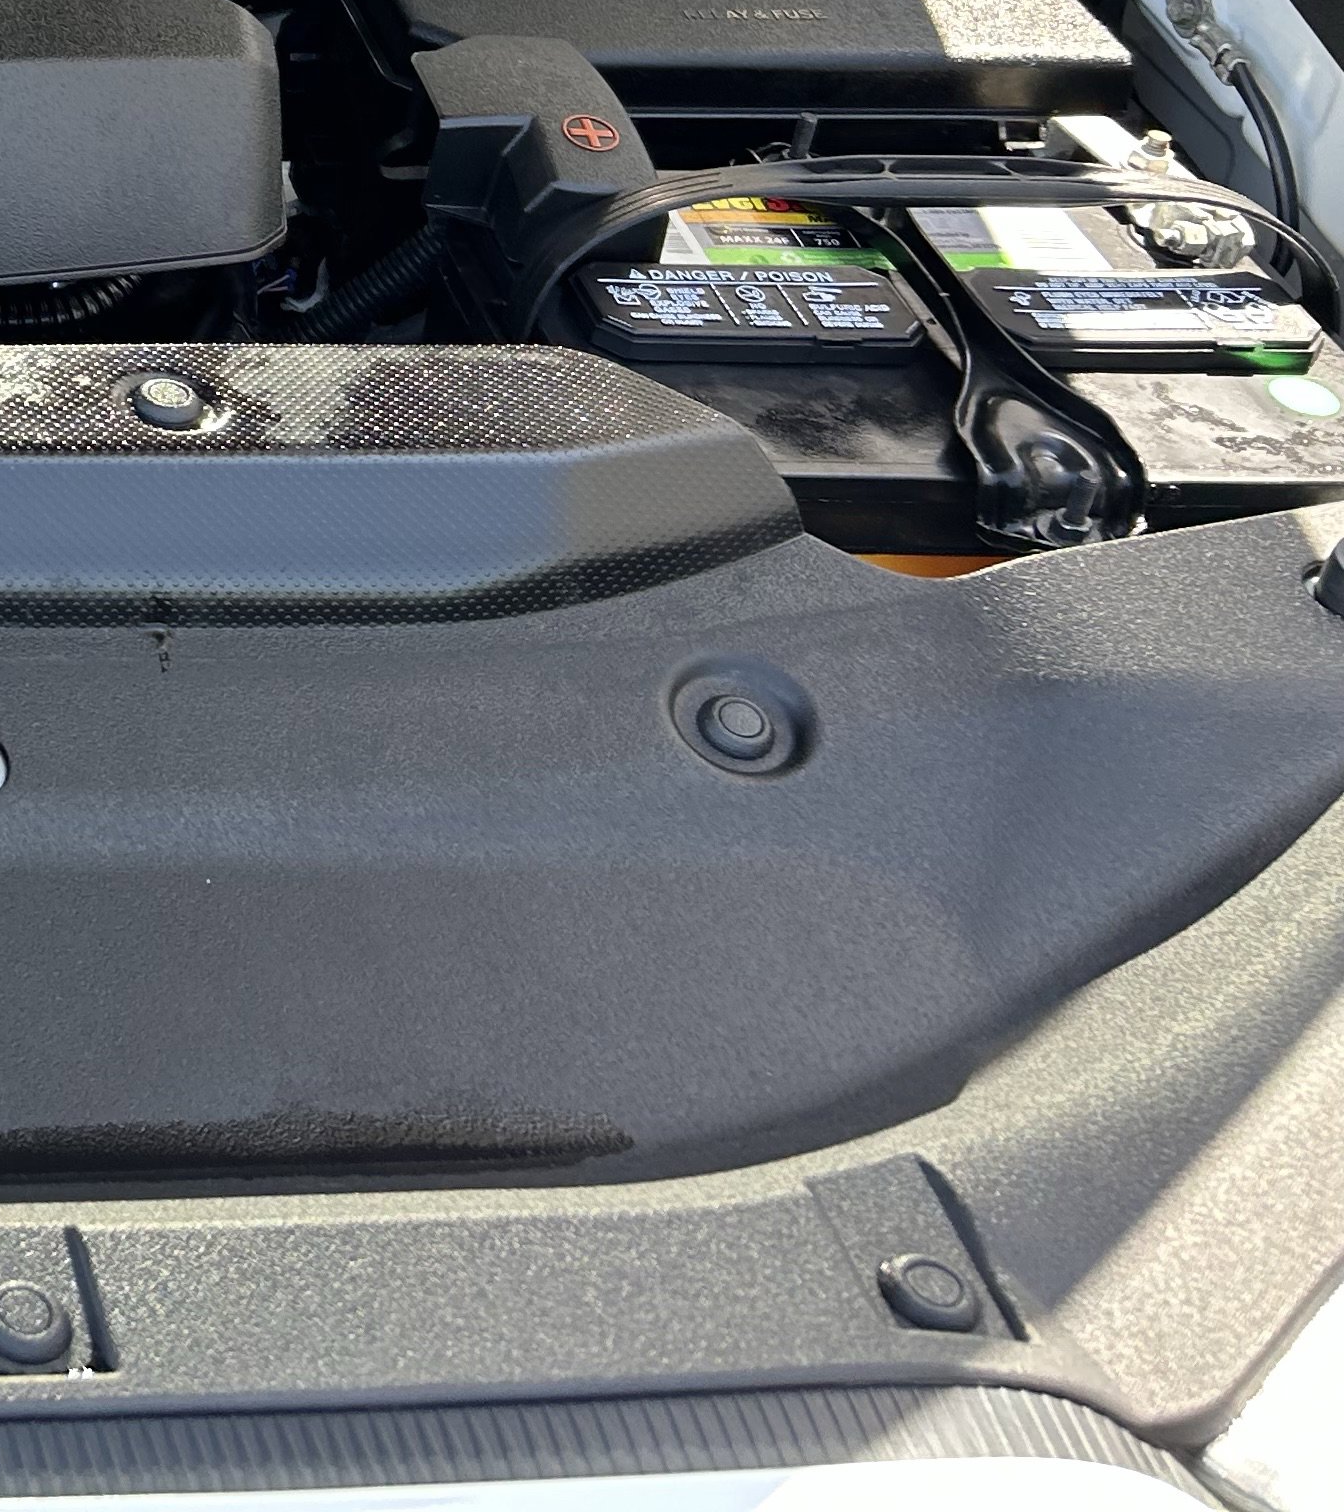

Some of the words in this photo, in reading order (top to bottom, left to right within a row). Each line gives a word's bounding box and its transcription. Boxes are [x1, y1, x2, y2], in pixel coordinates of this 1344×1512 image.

[770, 9, 829, 21] FUSE
[719, 234, 763, 244] MAXX
[648, 270, 736, 282] DANGER
[755, 271, 834, 283] POISON
